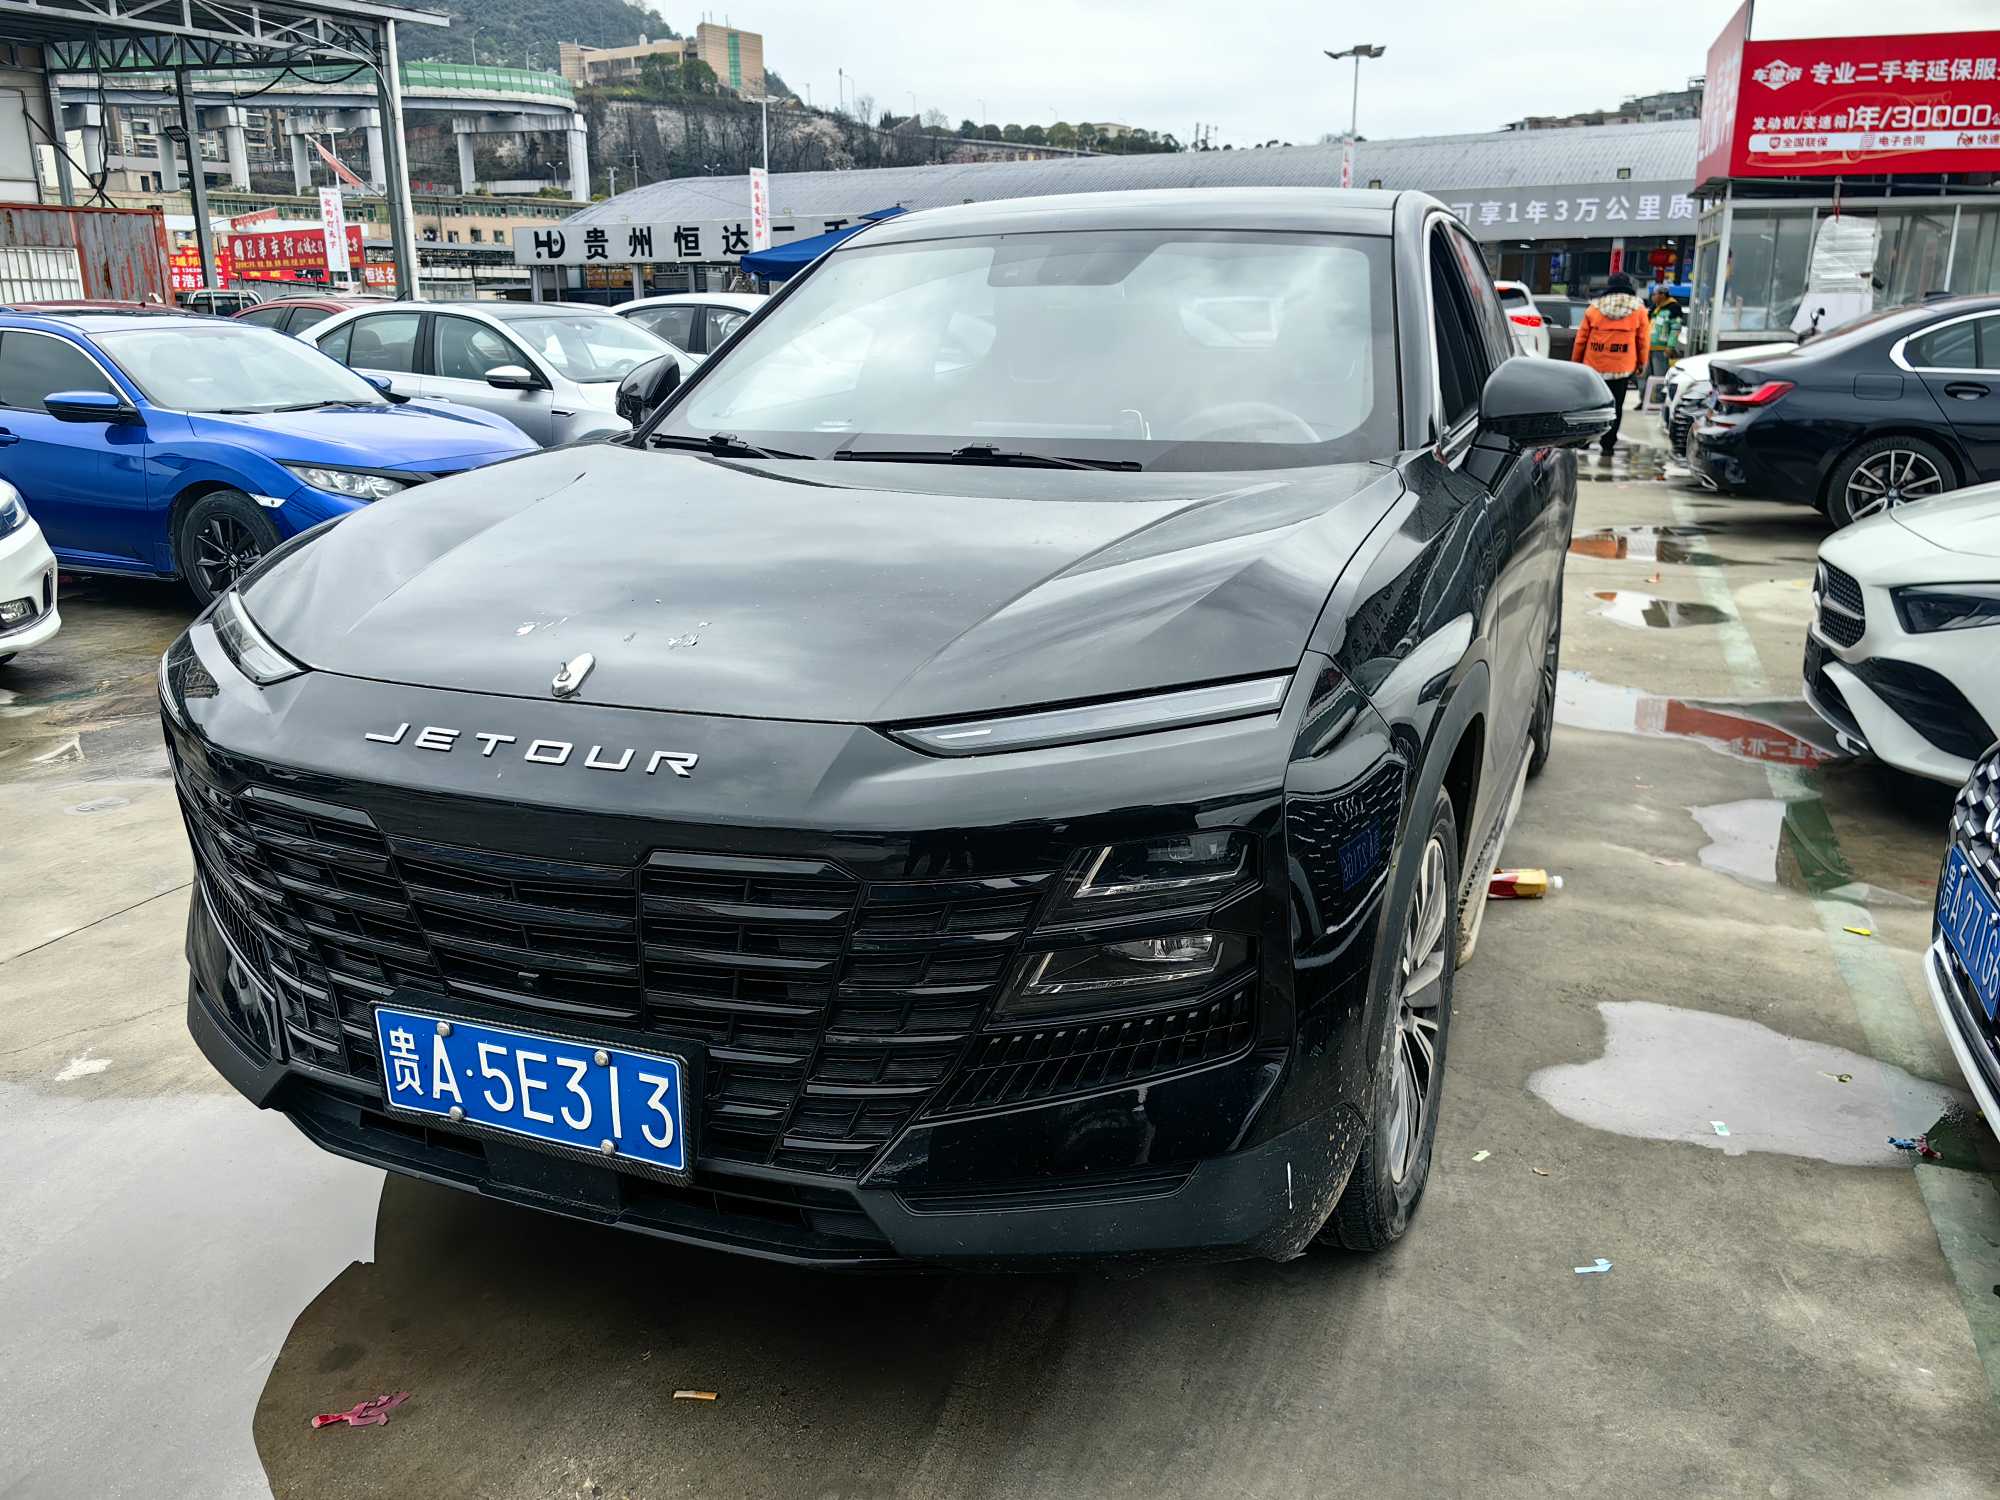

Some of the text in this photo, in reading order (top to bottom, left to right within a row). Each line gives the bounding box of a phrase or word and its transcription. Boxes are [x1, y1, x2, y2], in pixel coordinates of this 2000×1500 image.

[1810, 58, 2000, 85] 专业二手车延保服
[1783, 137, 1828, 148] 全国联保
[1878, 135, 1926, 146] 电子合同
[365, 722, 700, 777] JETOUR
[389, 1026, 674, 1149] 贵A·5E313
